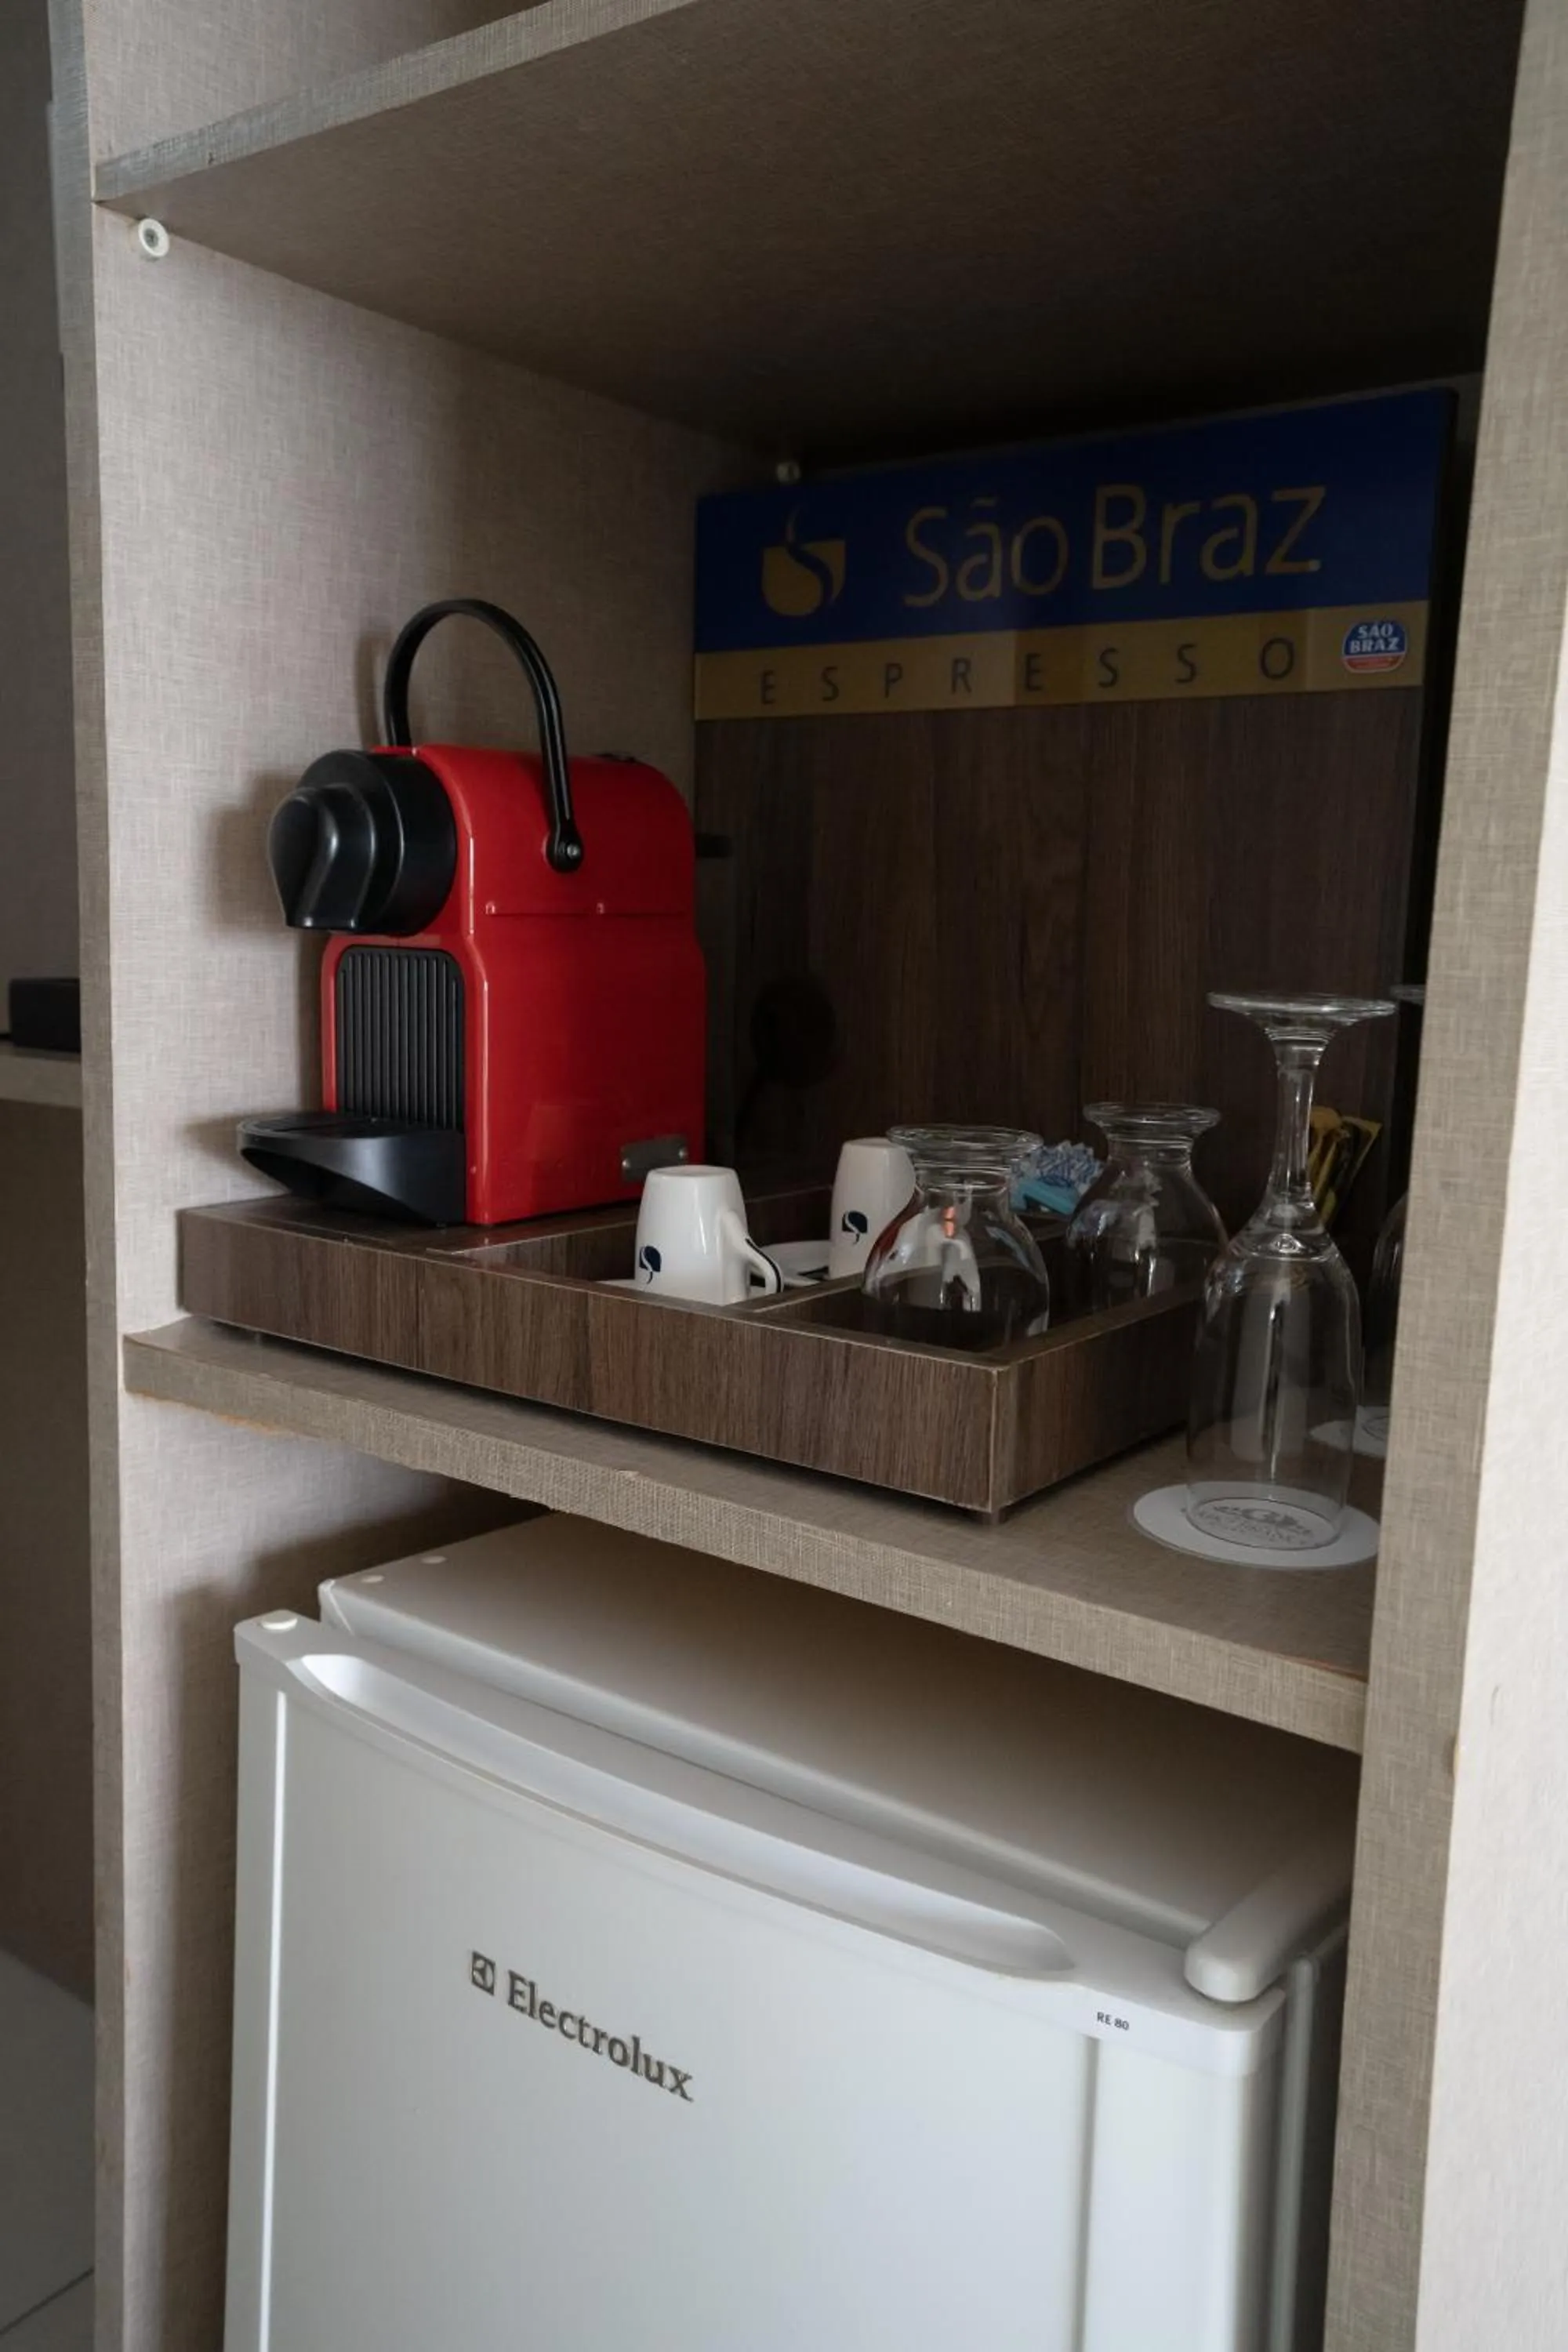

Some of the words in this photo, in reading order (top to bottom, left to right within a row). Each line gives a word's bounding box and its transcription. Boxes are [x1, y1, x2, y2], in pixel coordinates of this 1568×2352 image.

[903, 495, 1069, 608] São
[1091, 483, 1327, 591] Braz
[760, 636, 1296, 705] ESPRESSO
[1349, 637, 1399, 654] BRAZ
[507, 1969, 694, 2103] Electrolux
[1097, 2011, 1111, 2025] RE
